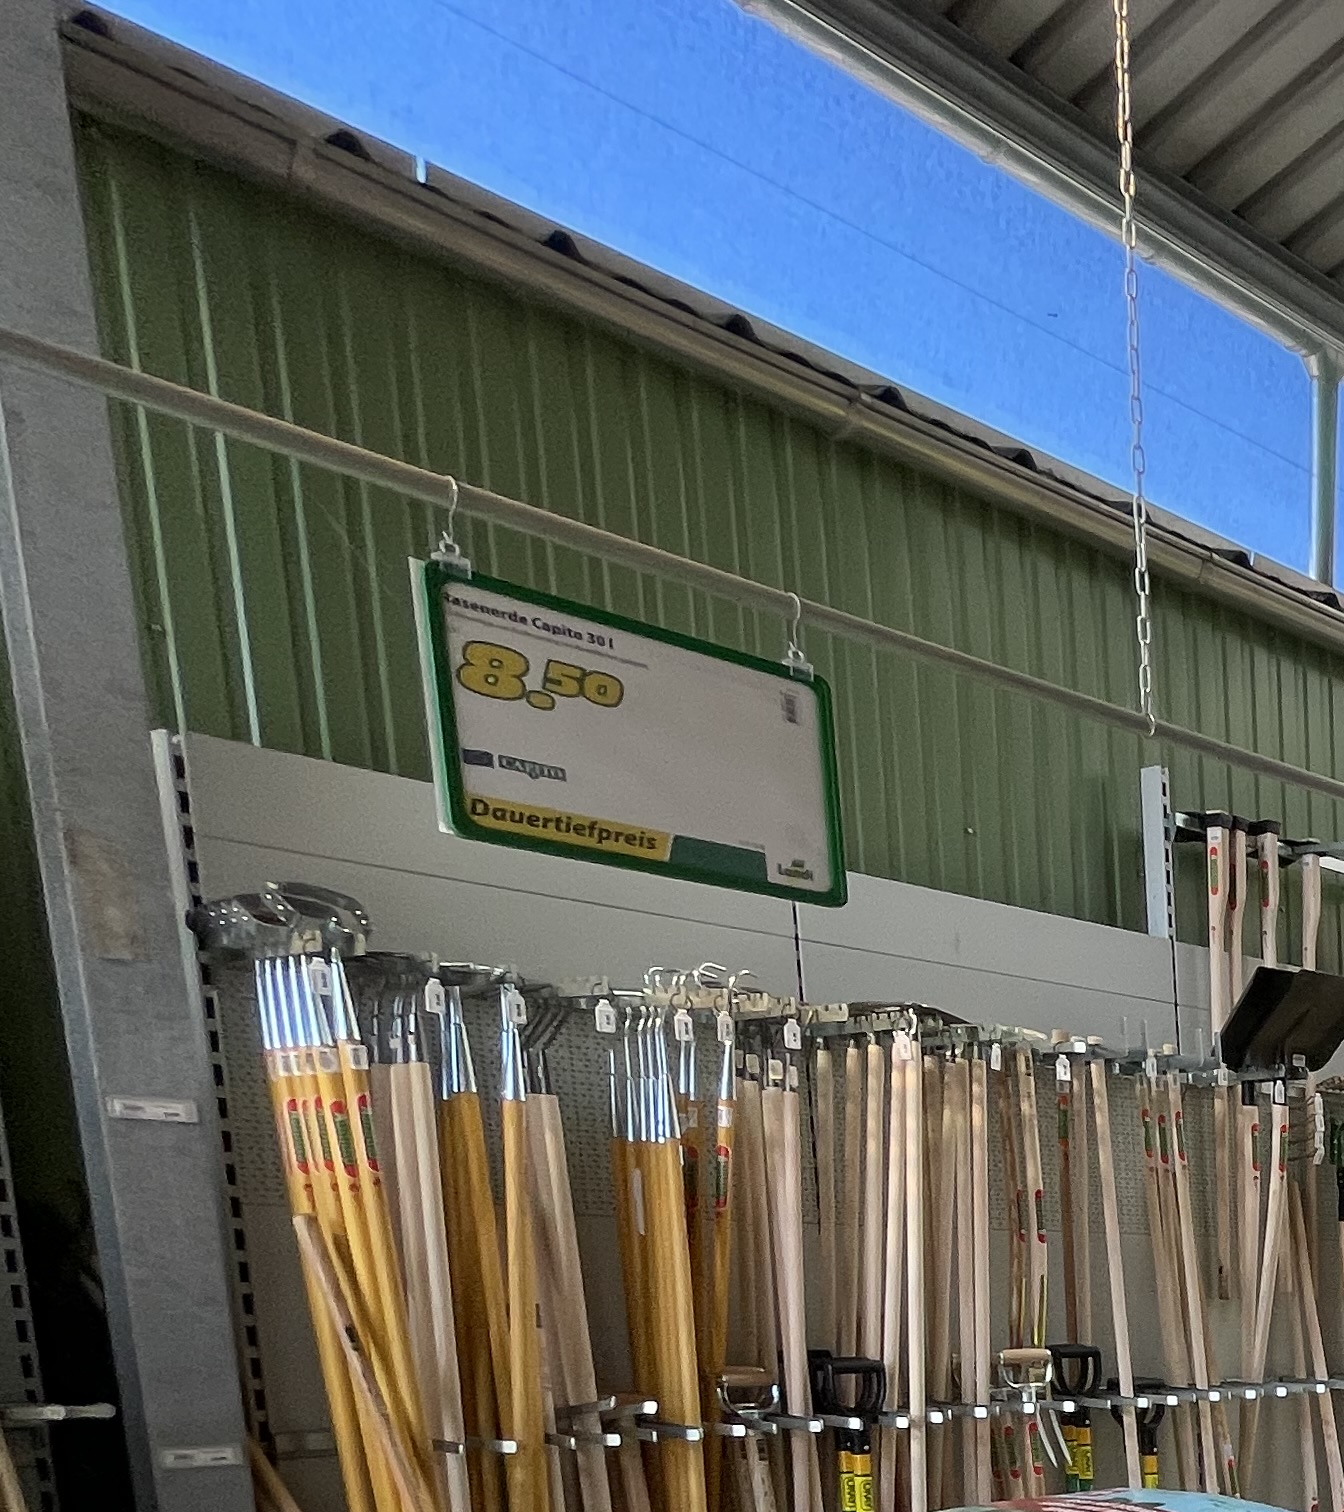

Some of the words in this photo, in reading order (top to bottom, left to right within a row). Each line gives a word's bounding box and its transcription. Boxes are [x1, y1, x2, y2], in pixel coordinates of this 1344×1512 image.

[532, 617, 583, 642] Capito
[457, 640, 625, 712] 8.50
[470, 797, 658, 852] Dauertiefpreis
